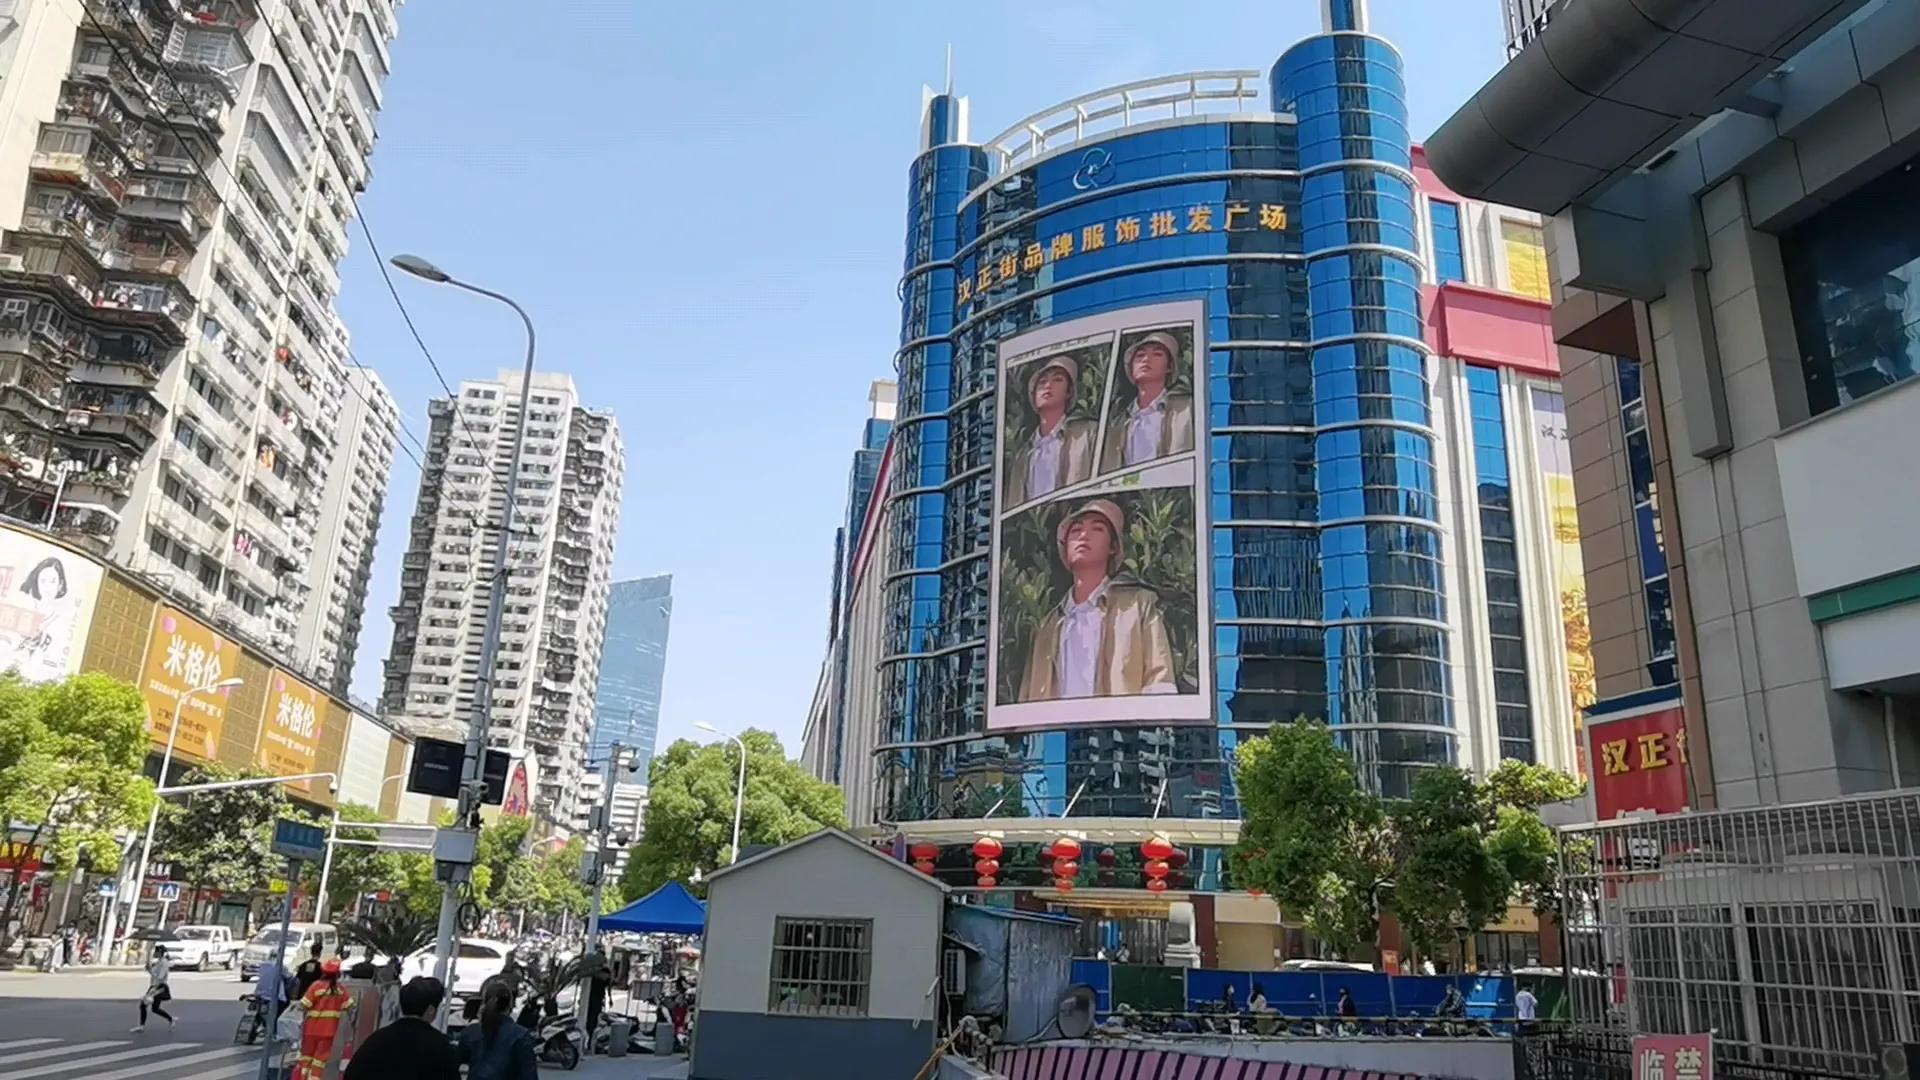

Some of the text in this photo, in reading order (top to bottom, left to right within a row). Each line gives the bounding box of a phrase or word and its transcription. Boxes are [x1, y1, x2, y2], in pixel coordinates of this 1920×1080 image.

[958, 203, 1288, 305] 汉正街品牌服饰批发广场
[163, 634, 222, 694] 米格伦
